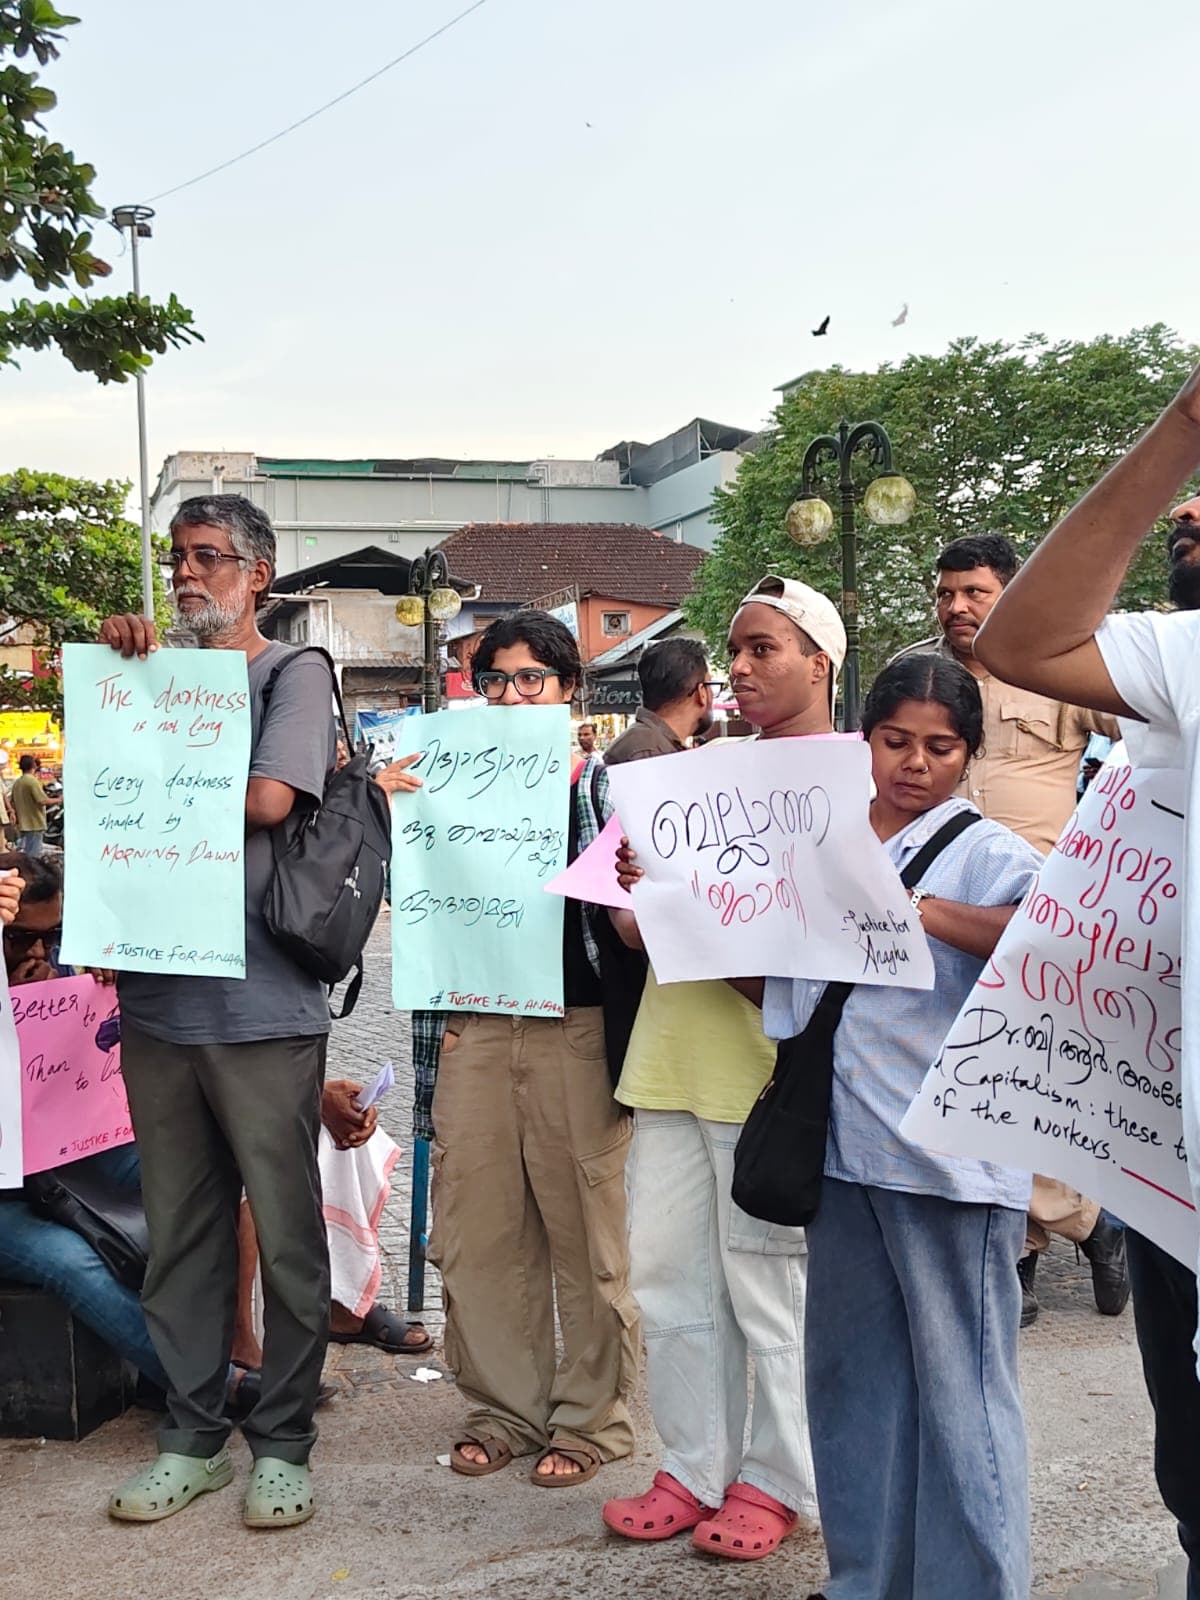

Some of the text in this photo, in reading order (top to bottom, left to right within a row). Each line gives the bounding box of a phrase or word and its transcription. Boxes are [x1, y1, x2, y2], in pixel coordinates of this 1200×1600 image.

[96, 673, 247, 714] The darkness
[132, 714, 223, 747] is not long
[94, 763, 234, 805] Every darkness
[183, 793, 194, 807] is
[160, 813, 182, 834] by
[886, 909, 911, 934] for
[859, 934, 911, 976] Anagha
[83, 1004, 96, 1028] to
[75, 1071, 89, 1091] to
[934, 1087, 958, 1118] of
[971, 1099, 1018, 1125] the
[1104, 1101, 1162, 1147] these
